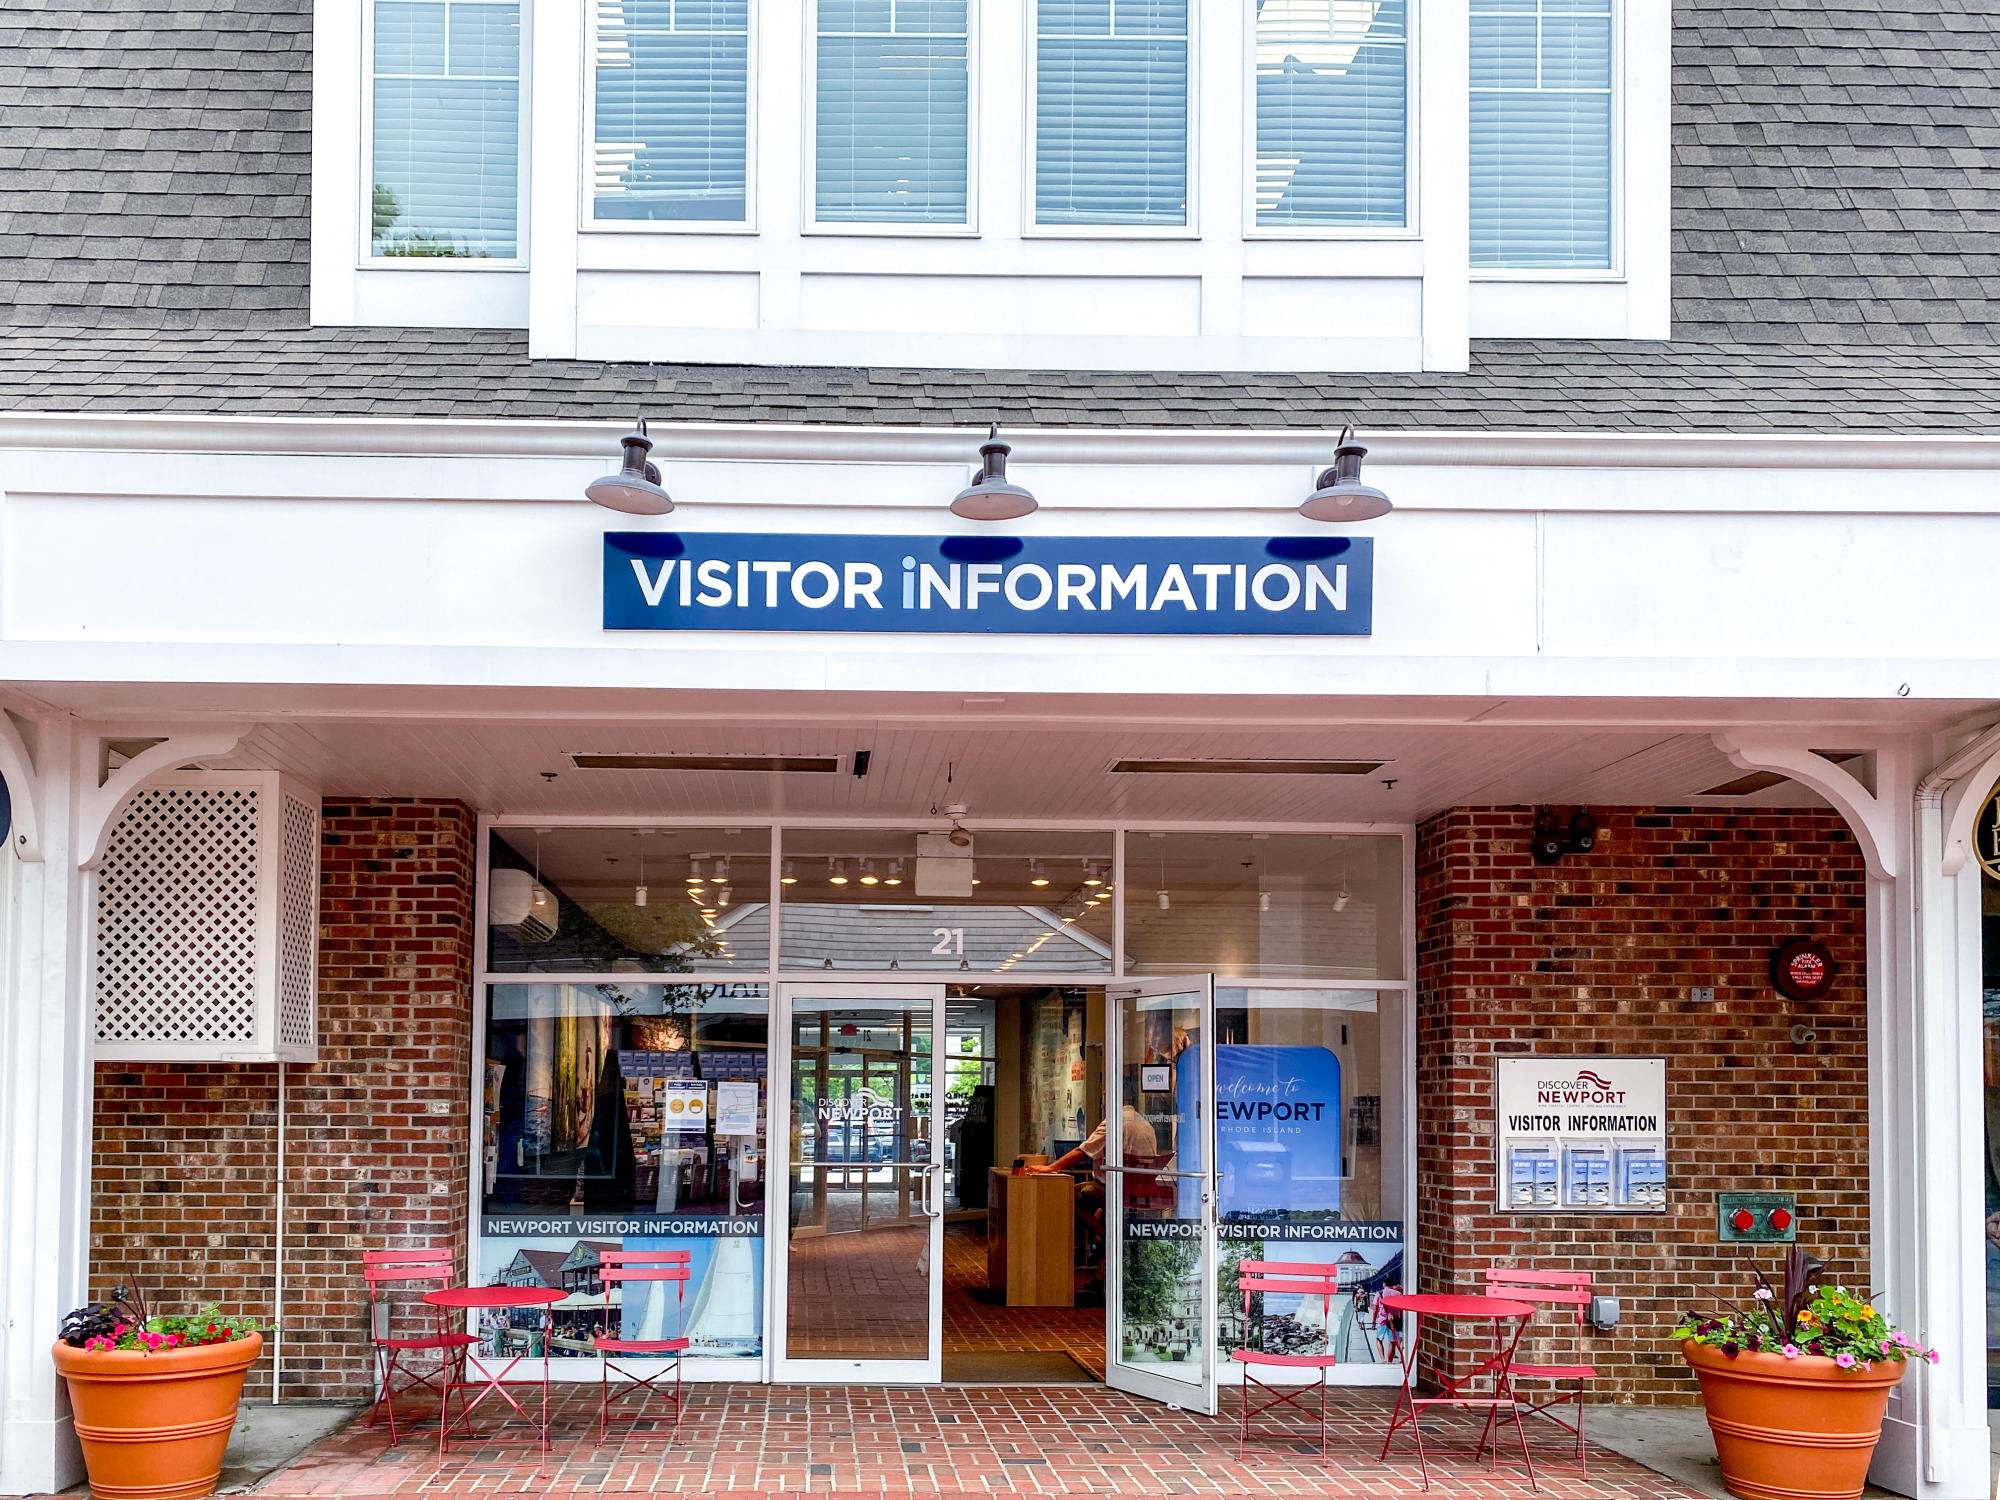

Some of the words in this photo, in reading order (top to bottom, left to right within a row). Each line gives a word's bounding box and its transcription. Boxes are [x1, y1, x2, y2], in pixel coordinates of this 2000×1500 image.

[630, 558, 883, 610] VISITOR
[901, 555, 1348, 612] iNFORMATION
[931, 927, 963, 955] 21
[1791, 953, 1823, 967] SPRINKLER
[1147, 1074, 1164, 1083] OPEN
[1537, 1081, 1588, 1090] DISCOVER
[1216, 1075, 1278, 1098] welcome
[1278, 1076, 1305, 1097] to
[818, 1098, 868, 1107] DISCOVER
[1538, 1091, 1626, 1104] NEWPORT
[818, 1107, 903, 1120] NEWPORT
[1196, 1100, 1326, 1122] EWPORT
[1221, 1126, 1257, 1134] RHODE
[1262, 1127, 1302, 1135] ISLAND
[1509, 1115, 1560, 1131] VISITOR
[1568, 1115, 1657, 1132] INFORMATION
[487, 1220, 571, 1234] NEWPORT
[576, 1220, 641, 1234] VISITOR
[1129, 1223, 1202, 1238] NEWPOR
[1218, 1224, 1280, 1238] VISITOR
